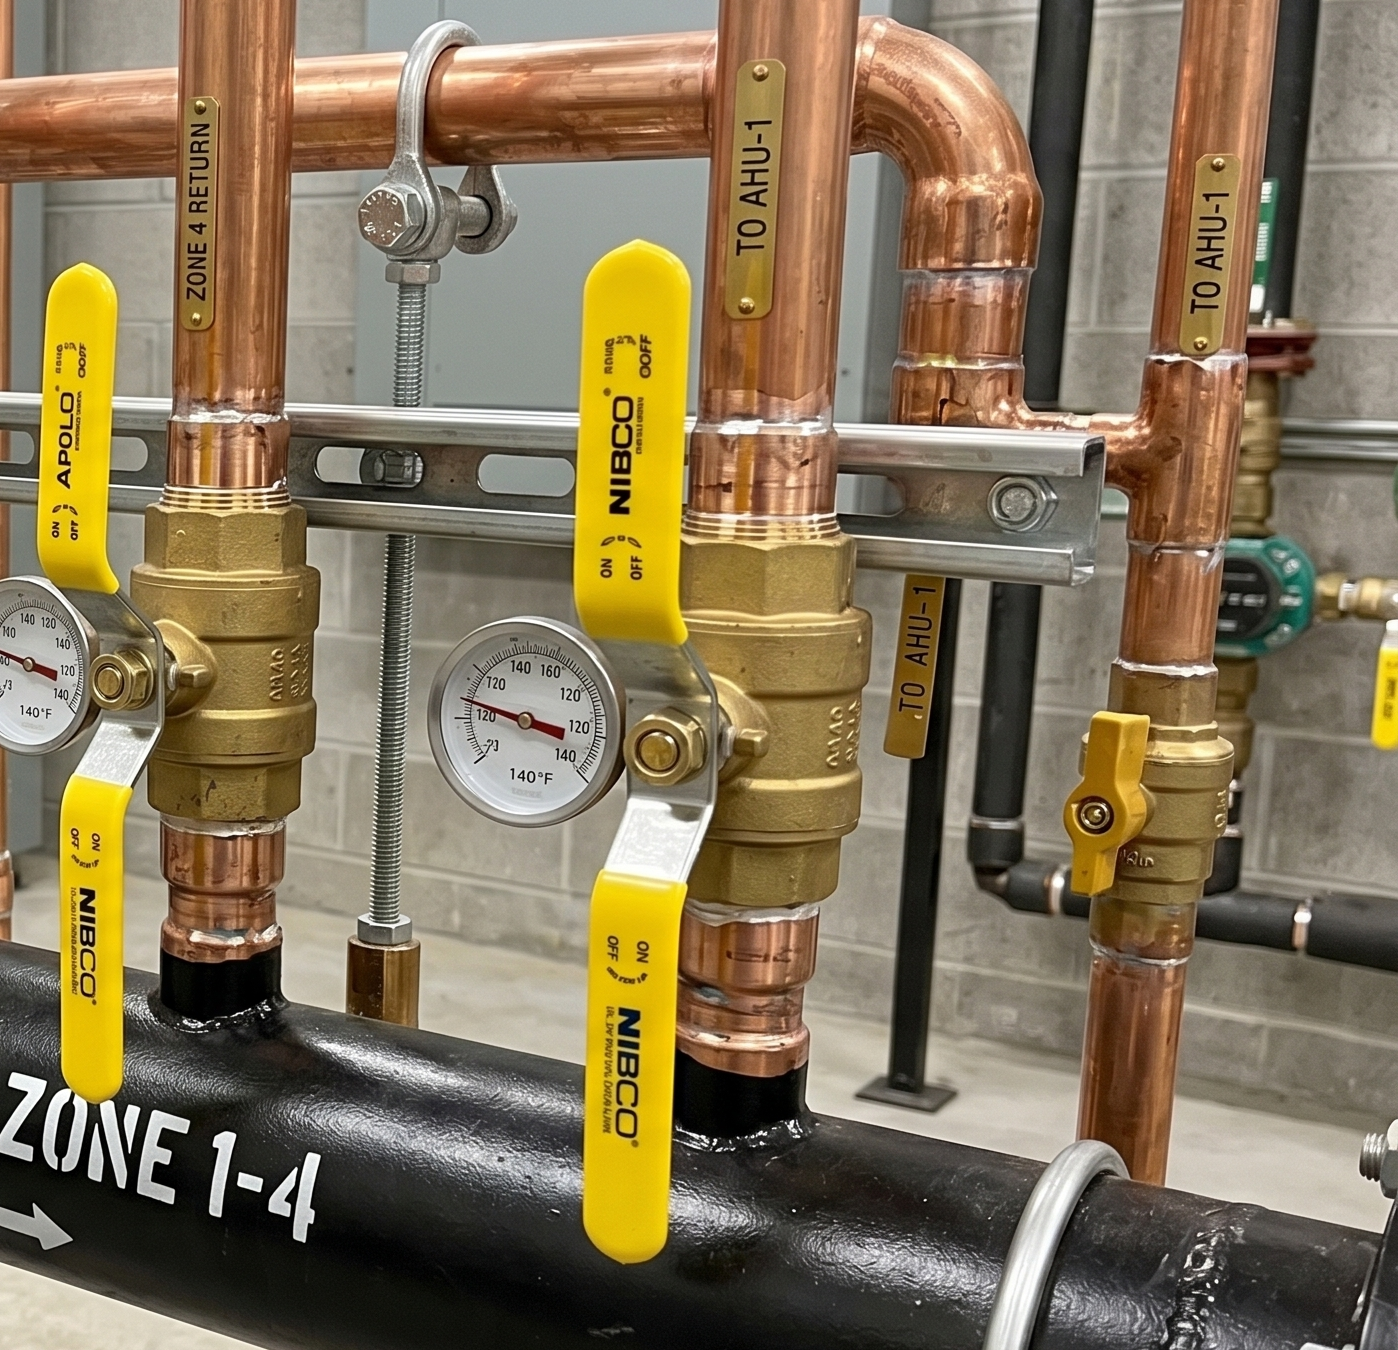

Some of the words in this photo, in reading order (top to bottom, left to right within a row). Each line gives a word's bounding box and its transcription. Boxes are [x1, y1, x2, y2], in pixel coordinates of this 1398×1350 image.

[188, 123, 210, 214] RETURN
[739, 120, 773, 208] AHU-1
[188, 222, 207, 235] 4
[736, 219, 767, 256] TO
[1194, 192, 1230, 271] AHU-1
[186, 243, 207, 301] ZONE
[1190, 281, 1221, 315] TO
[56, 391, 74, 490] APOLO
[608, 395, 634, 516] NIBCO
[51, 521, 60, 538] ON
[600, 557, 613, 579] ON
[630, 555, 643, 581] OFF
[20, 613, 36, 626] 140
[904, 585, 936, 667] AHU-1
[55, 637, 71, 650] 140
[60, 664, 75, 677] 120
[510, 660, 532, 674] 140
[540, 664, 561, 679] 160
[53, 688, 69, 701] 140
[560, 687, 581, 702] 120
[898, 682, 926, 713] TO
[476, 708, 496, 722] 120
[569, 720, 590, 735] 120
[555, 748, 577, 763] 140
[70, 827, 80, 850] OFF
[91, 832, 101, 852] ON
[79, 887, 97, 999] NIBCO
[606, 935, 620, 962] OFF
[637, 940, 650, 964] ON
[615, 1006, 642, 1140] NIBCO
[208, 1131, 322, 1243] 1-4
